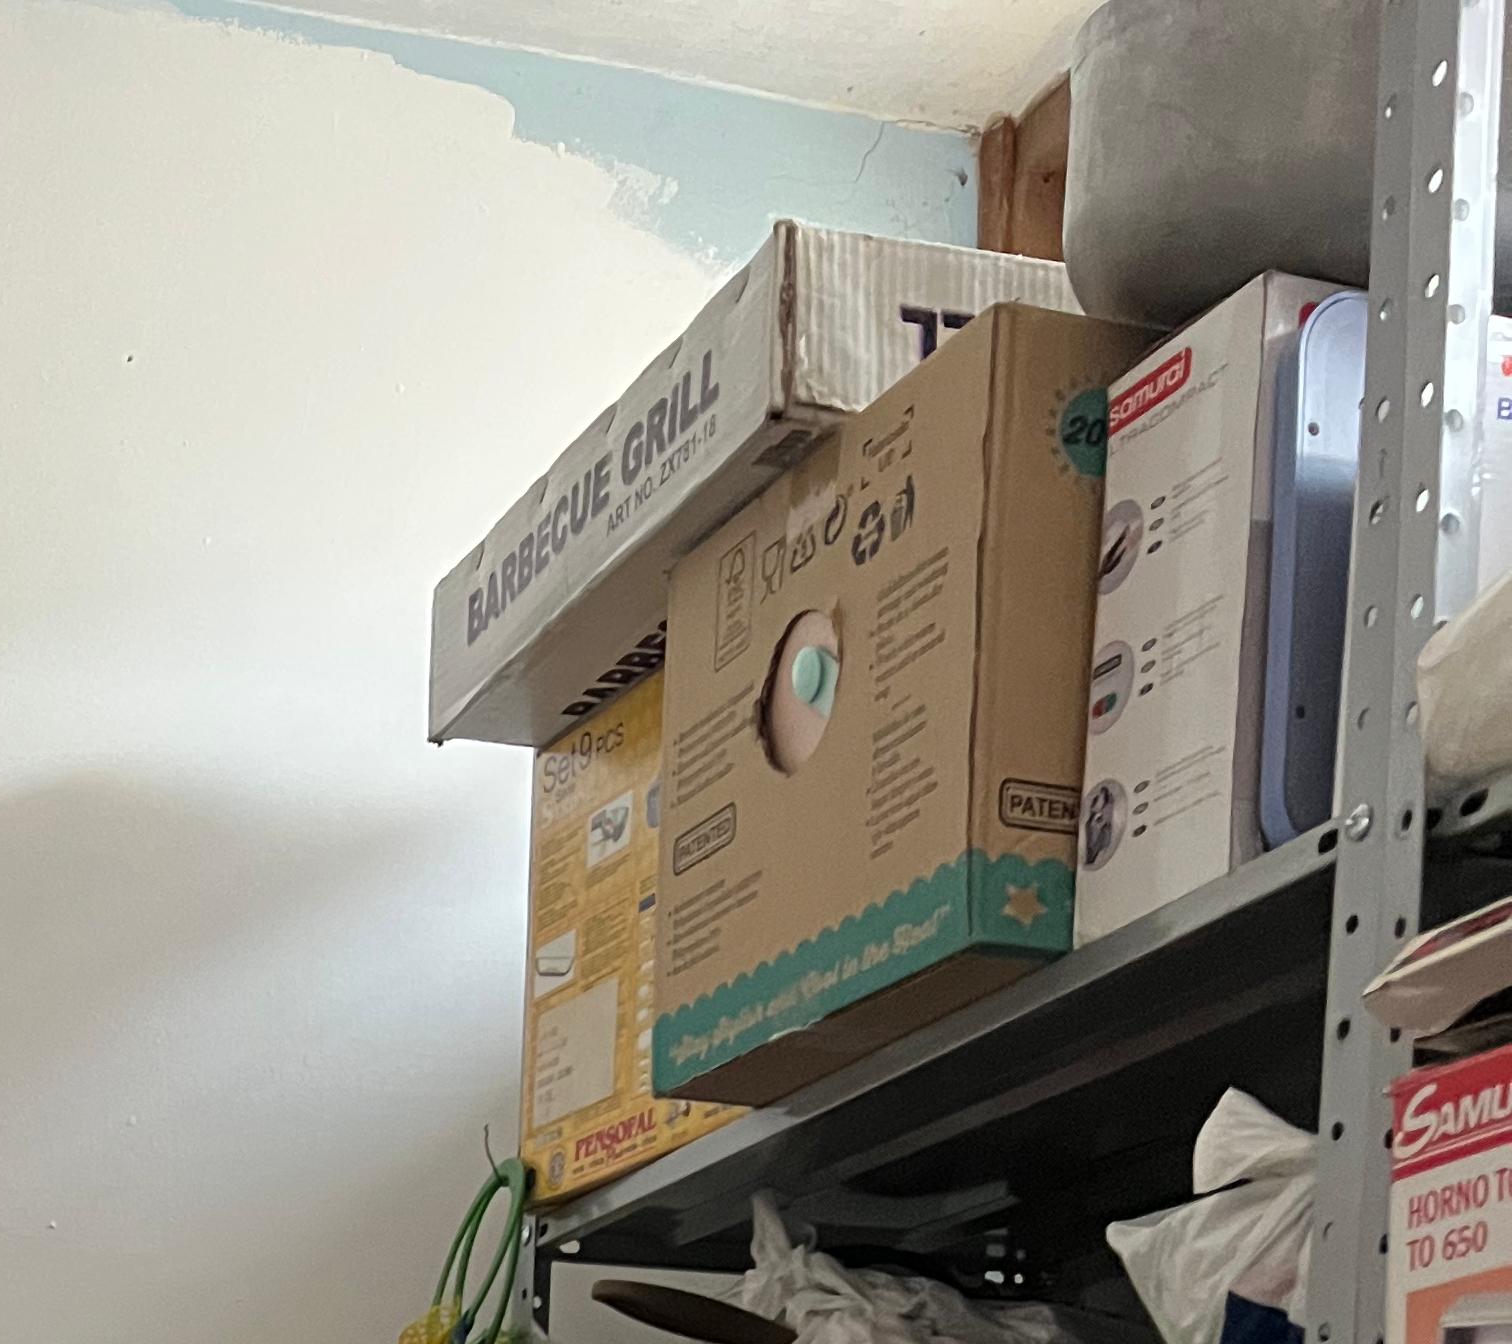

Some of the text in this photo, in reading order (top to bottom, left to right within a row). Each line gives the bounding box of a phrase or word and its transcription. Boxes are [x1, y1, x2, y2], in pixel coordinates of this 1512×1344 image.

[466, 452, 613, 647] BARBECUE
[620, 349, 720, 486] GRILL
[1408, 1173, 1489, 1230] HORNO
[1406, 1220, 1488, 1272] TO 650
